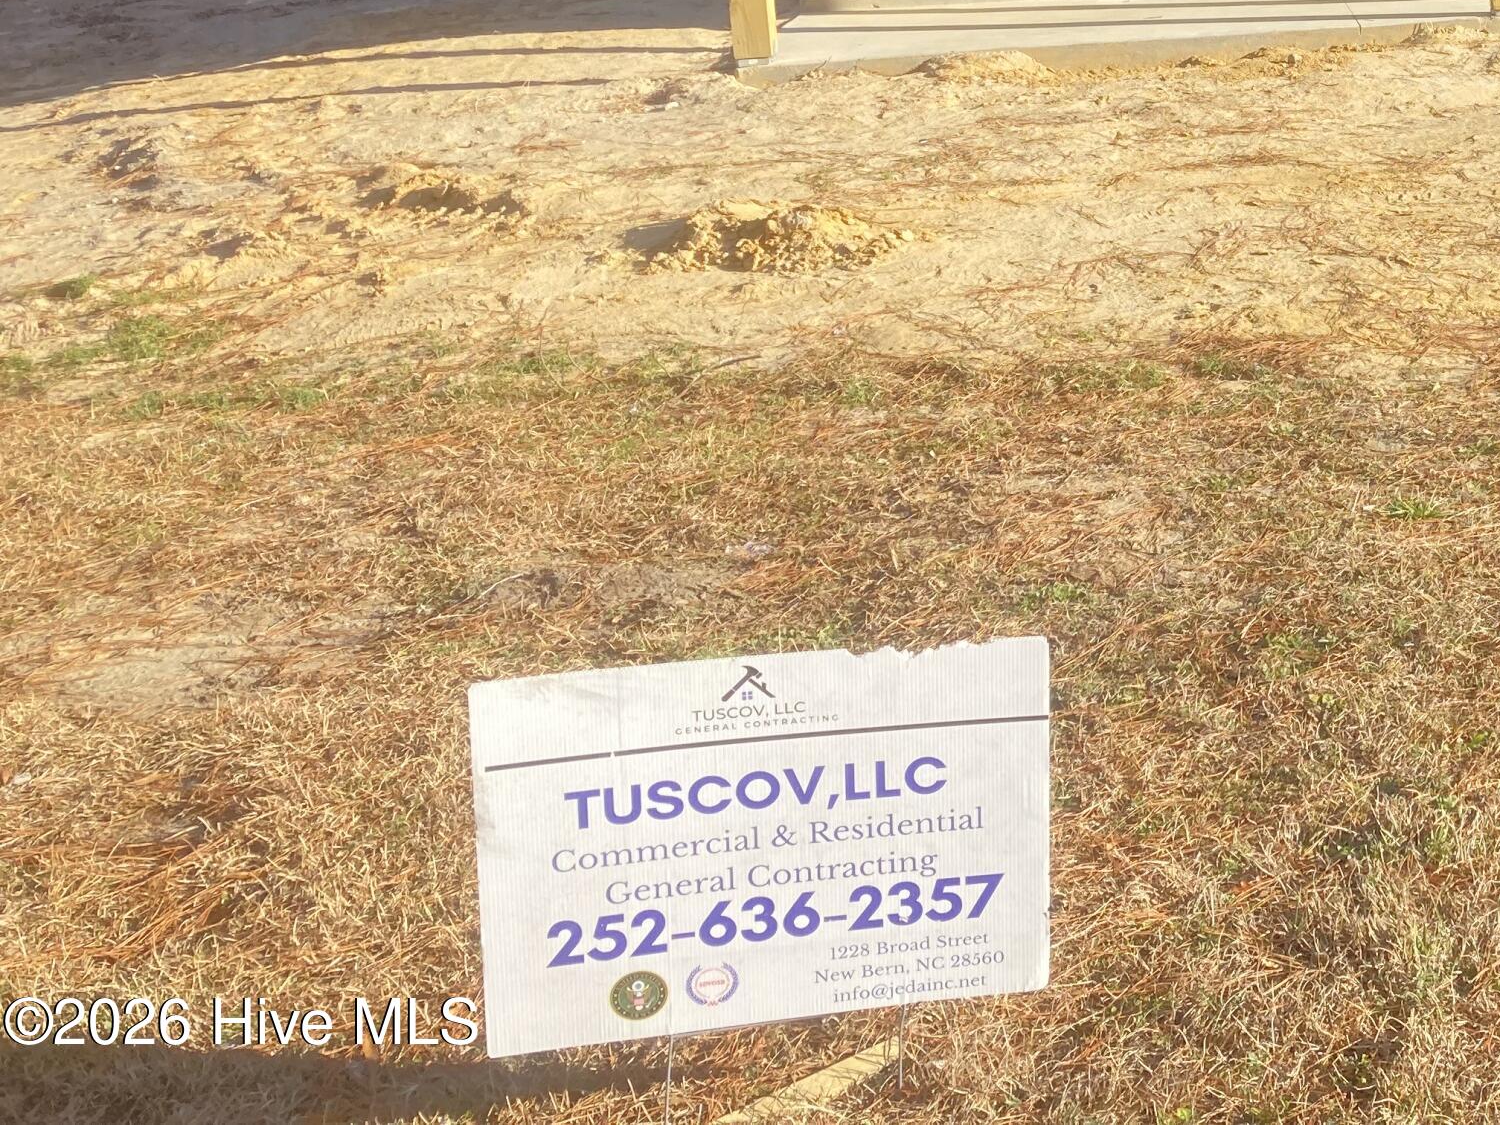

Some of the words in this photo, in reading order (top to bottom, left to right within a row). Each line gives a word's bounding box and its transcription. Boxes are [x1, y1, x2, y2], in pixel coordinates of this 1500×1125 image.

[675, 722, 737, 735] GENERAL
[744, 714, 839, 729] CONTRACTING
[692, 704, 769, 722] TUSCOV,
[774, 701, 806, 715] LLC
[564, 756, 948, 829] TUSCOV,LLC
[551, 827, 760, 874] Commercial
[771, 824, 798, 847] &
[809, 806, 984, 843] Residential
[605, 867, 736, 906] General
[746, 849, 939, 888] Contracting
[546, 873, 1006, 968] 252-636-2357
[829, 943, 870, 962] 1228
[876, 937, 931, 956] Broad
[935, 932, 989, 951] Street
[814, 965, 856, 984] New
[861, 960, 910, 981] Bern,
[916, 955, 946, 972] NC
[950, 950, 1005, 967] 28560
[832, 974, 987, 1004] info@jedainc.net
